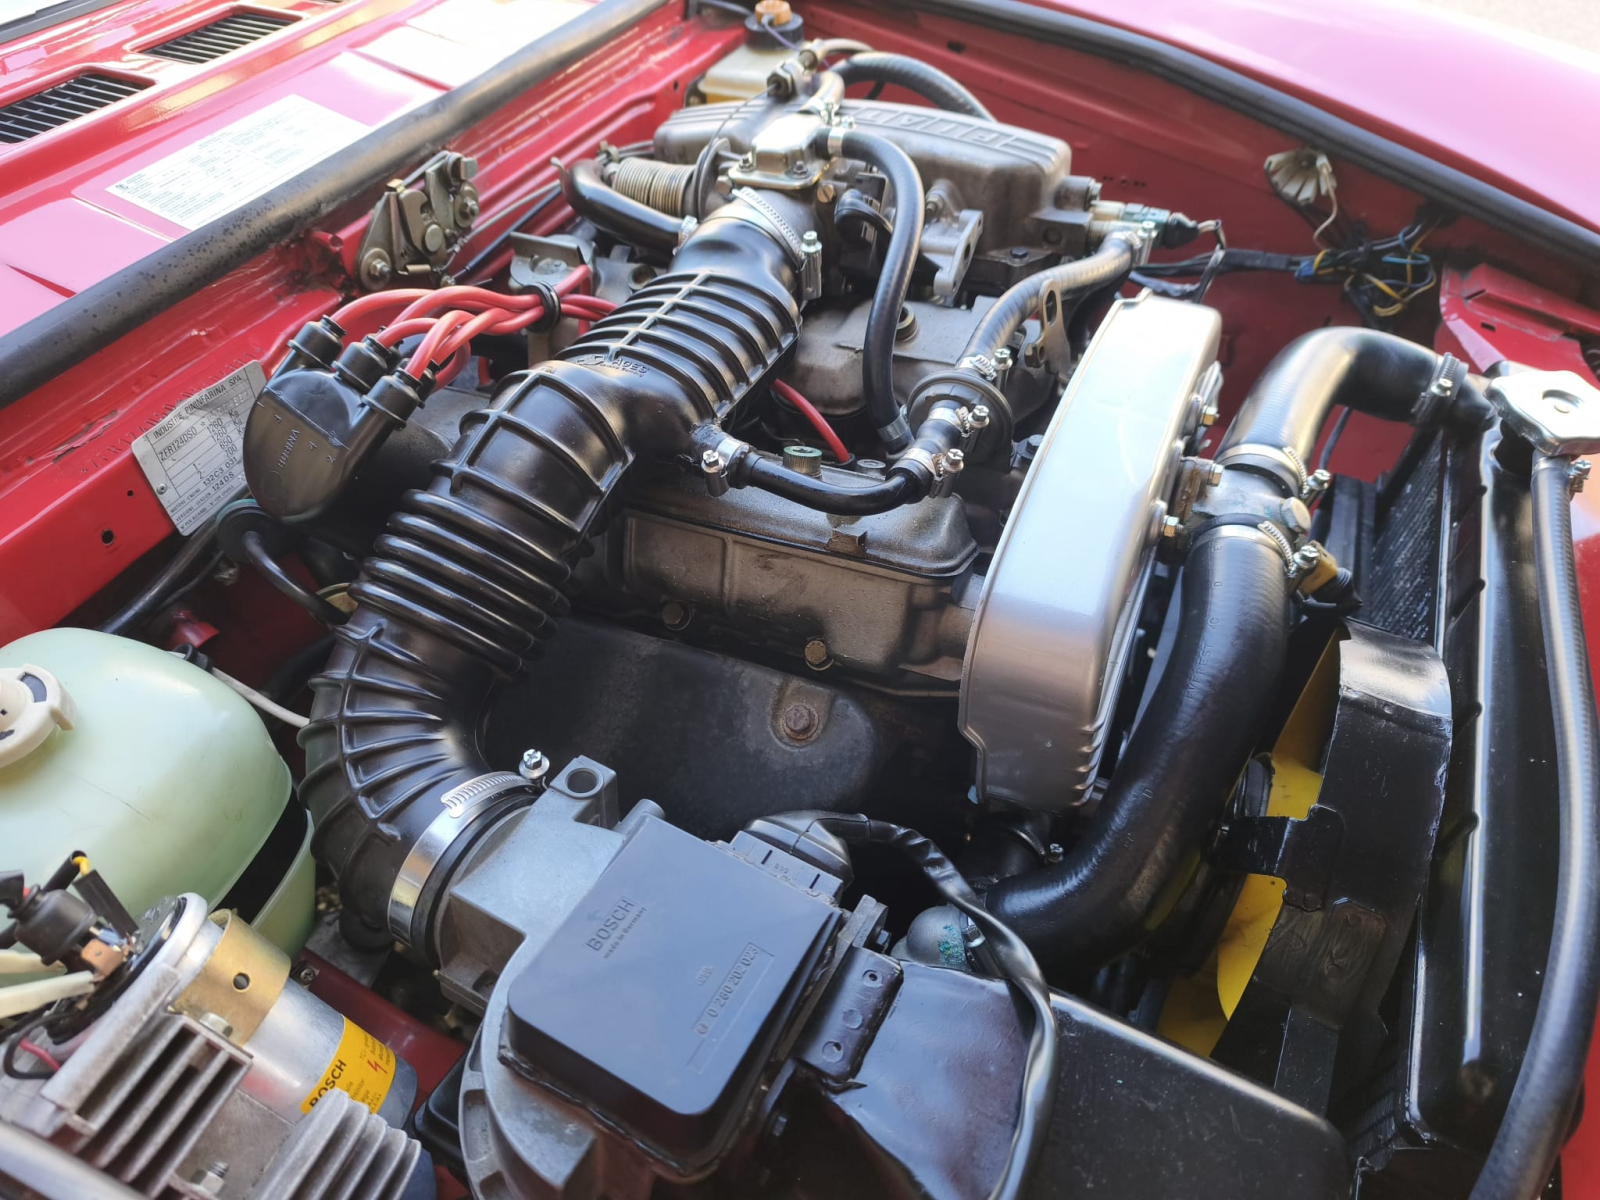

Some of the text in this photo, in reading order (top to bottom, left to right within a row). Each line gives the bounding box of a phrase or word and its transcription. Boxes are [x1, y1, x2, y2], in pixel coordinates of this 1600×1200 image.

[153, 411, 183, 439] INDUSTRIE
[184, 384, 227, 414] PININFARINA
[206, 409, 239, 434] 1260 Kg
[211, 417, 243, 443] 1260 Kg
[220, 435, 233, 450] 650
[225, 443, 238, 458] 700
[203, 468, 225, 487] 132C3
[225, 456, 238, 469] 031
[586, 897, 635, 951] BOSCH
